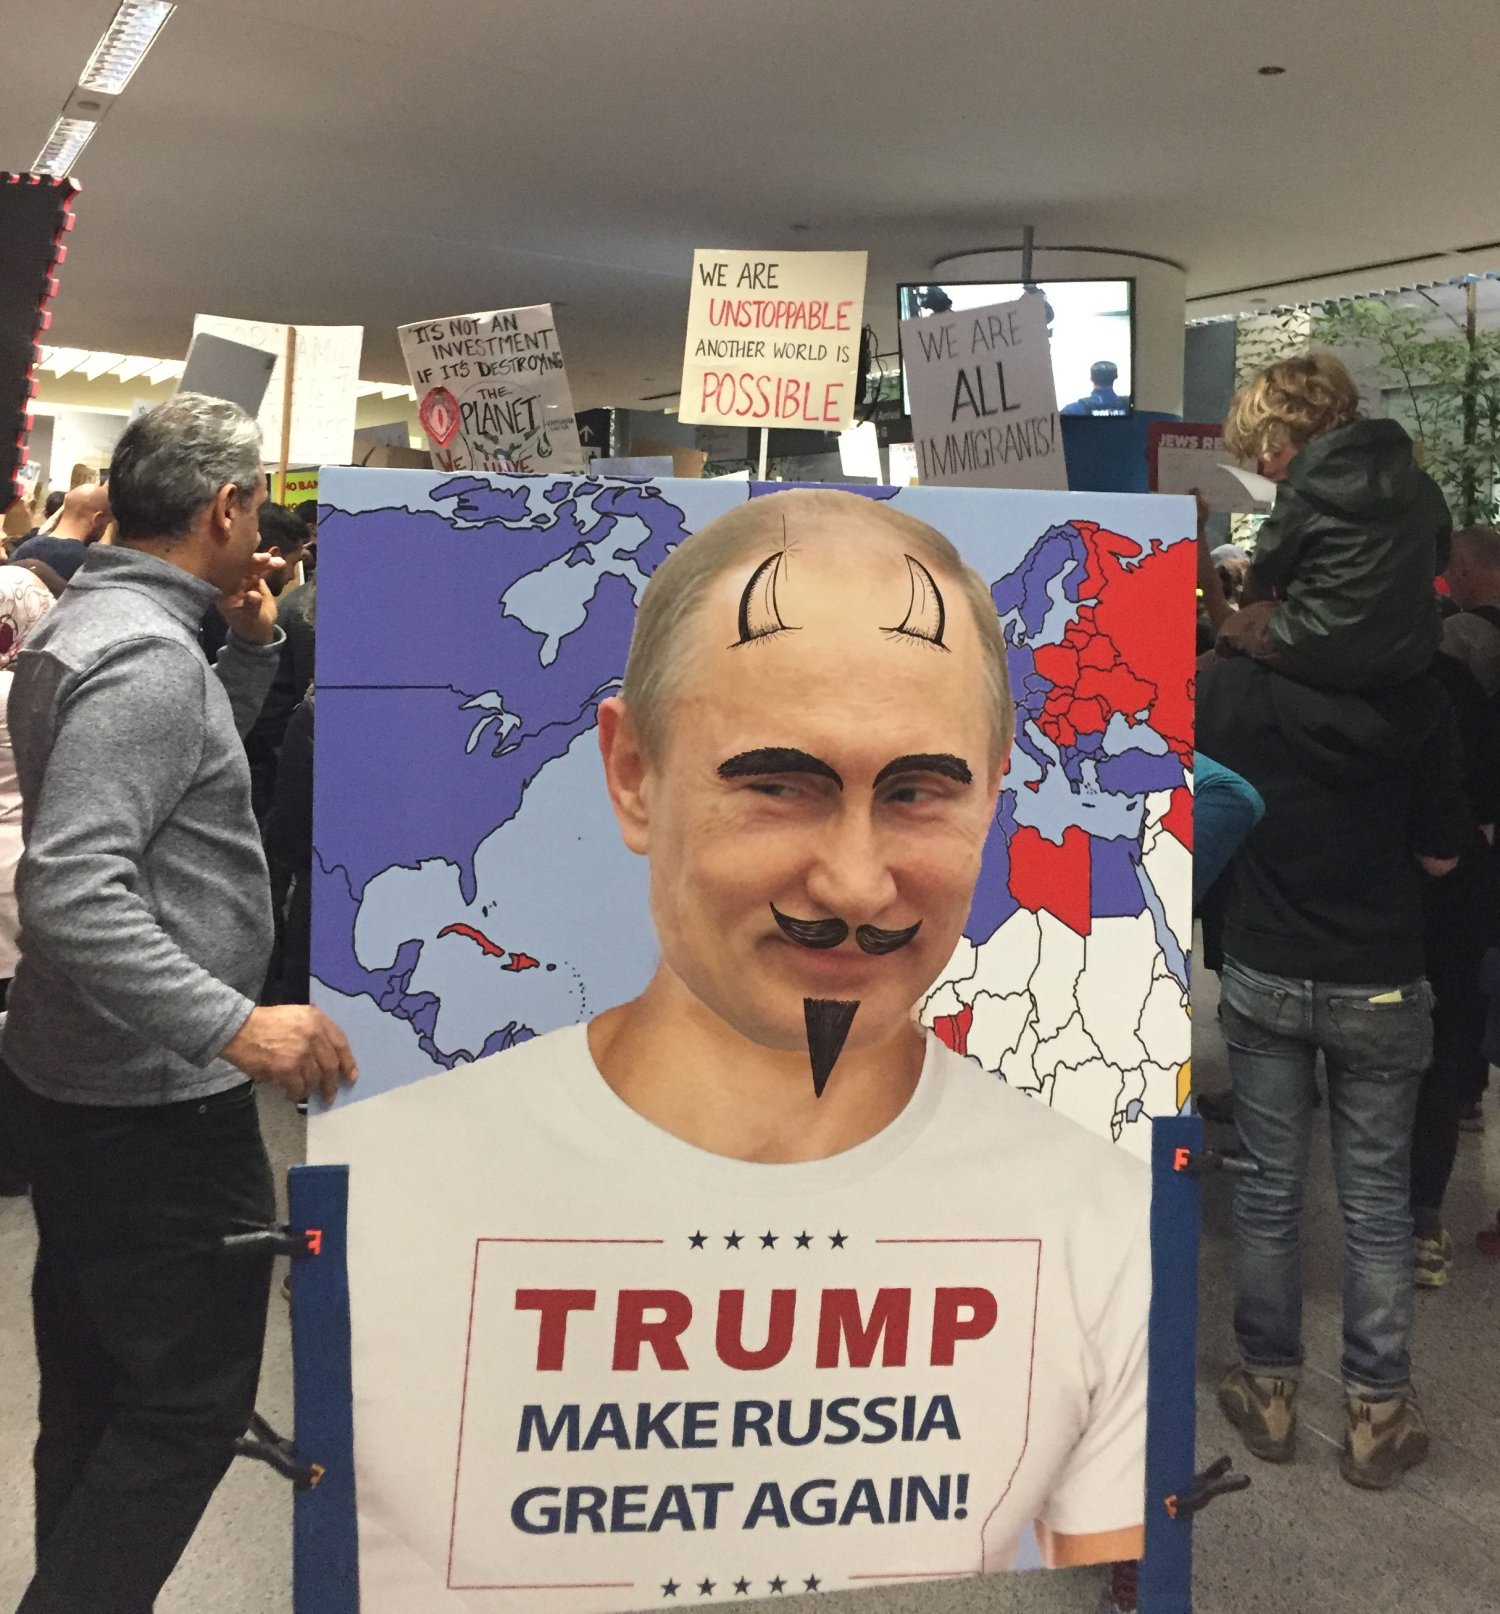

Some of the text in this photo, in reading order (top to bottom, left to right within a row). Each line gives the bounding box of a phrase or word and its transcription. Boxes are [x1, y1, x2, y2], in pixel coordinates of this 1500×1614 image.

[699, 263, 779, 289] WE ARE
[450, 317, 480, 337] NOT
[491, 313, 518, 332] AN
[709, 298, 854, 331] UNSTOPPABLE
[432, 328, 553, 360] INVESTMENT
[695, 339, 850, 363] ANOTHER WORLD IS
[917, 310, 1022, 362] WE ARE
[417, 368, 432, 384] IF
[474, 352, 563, 375] DESTROYING
[477, 386, 513, 400] THE
[701, 372, 844, 422] POSSIBLE
[952, 361, 1021, 422] ALL
[459, 396, 537, 435] PLANET
[920, 412, 1055, 480] IMMIGRANTS!
[1159, 434, 1198, 449] JEWS
[515, 1286, 998, 1372] TRUMP
[516, 1394, 961, 1452] MAKE RUSSIA
[511, 1473, 969, 1534] GREAT AGAIN!
